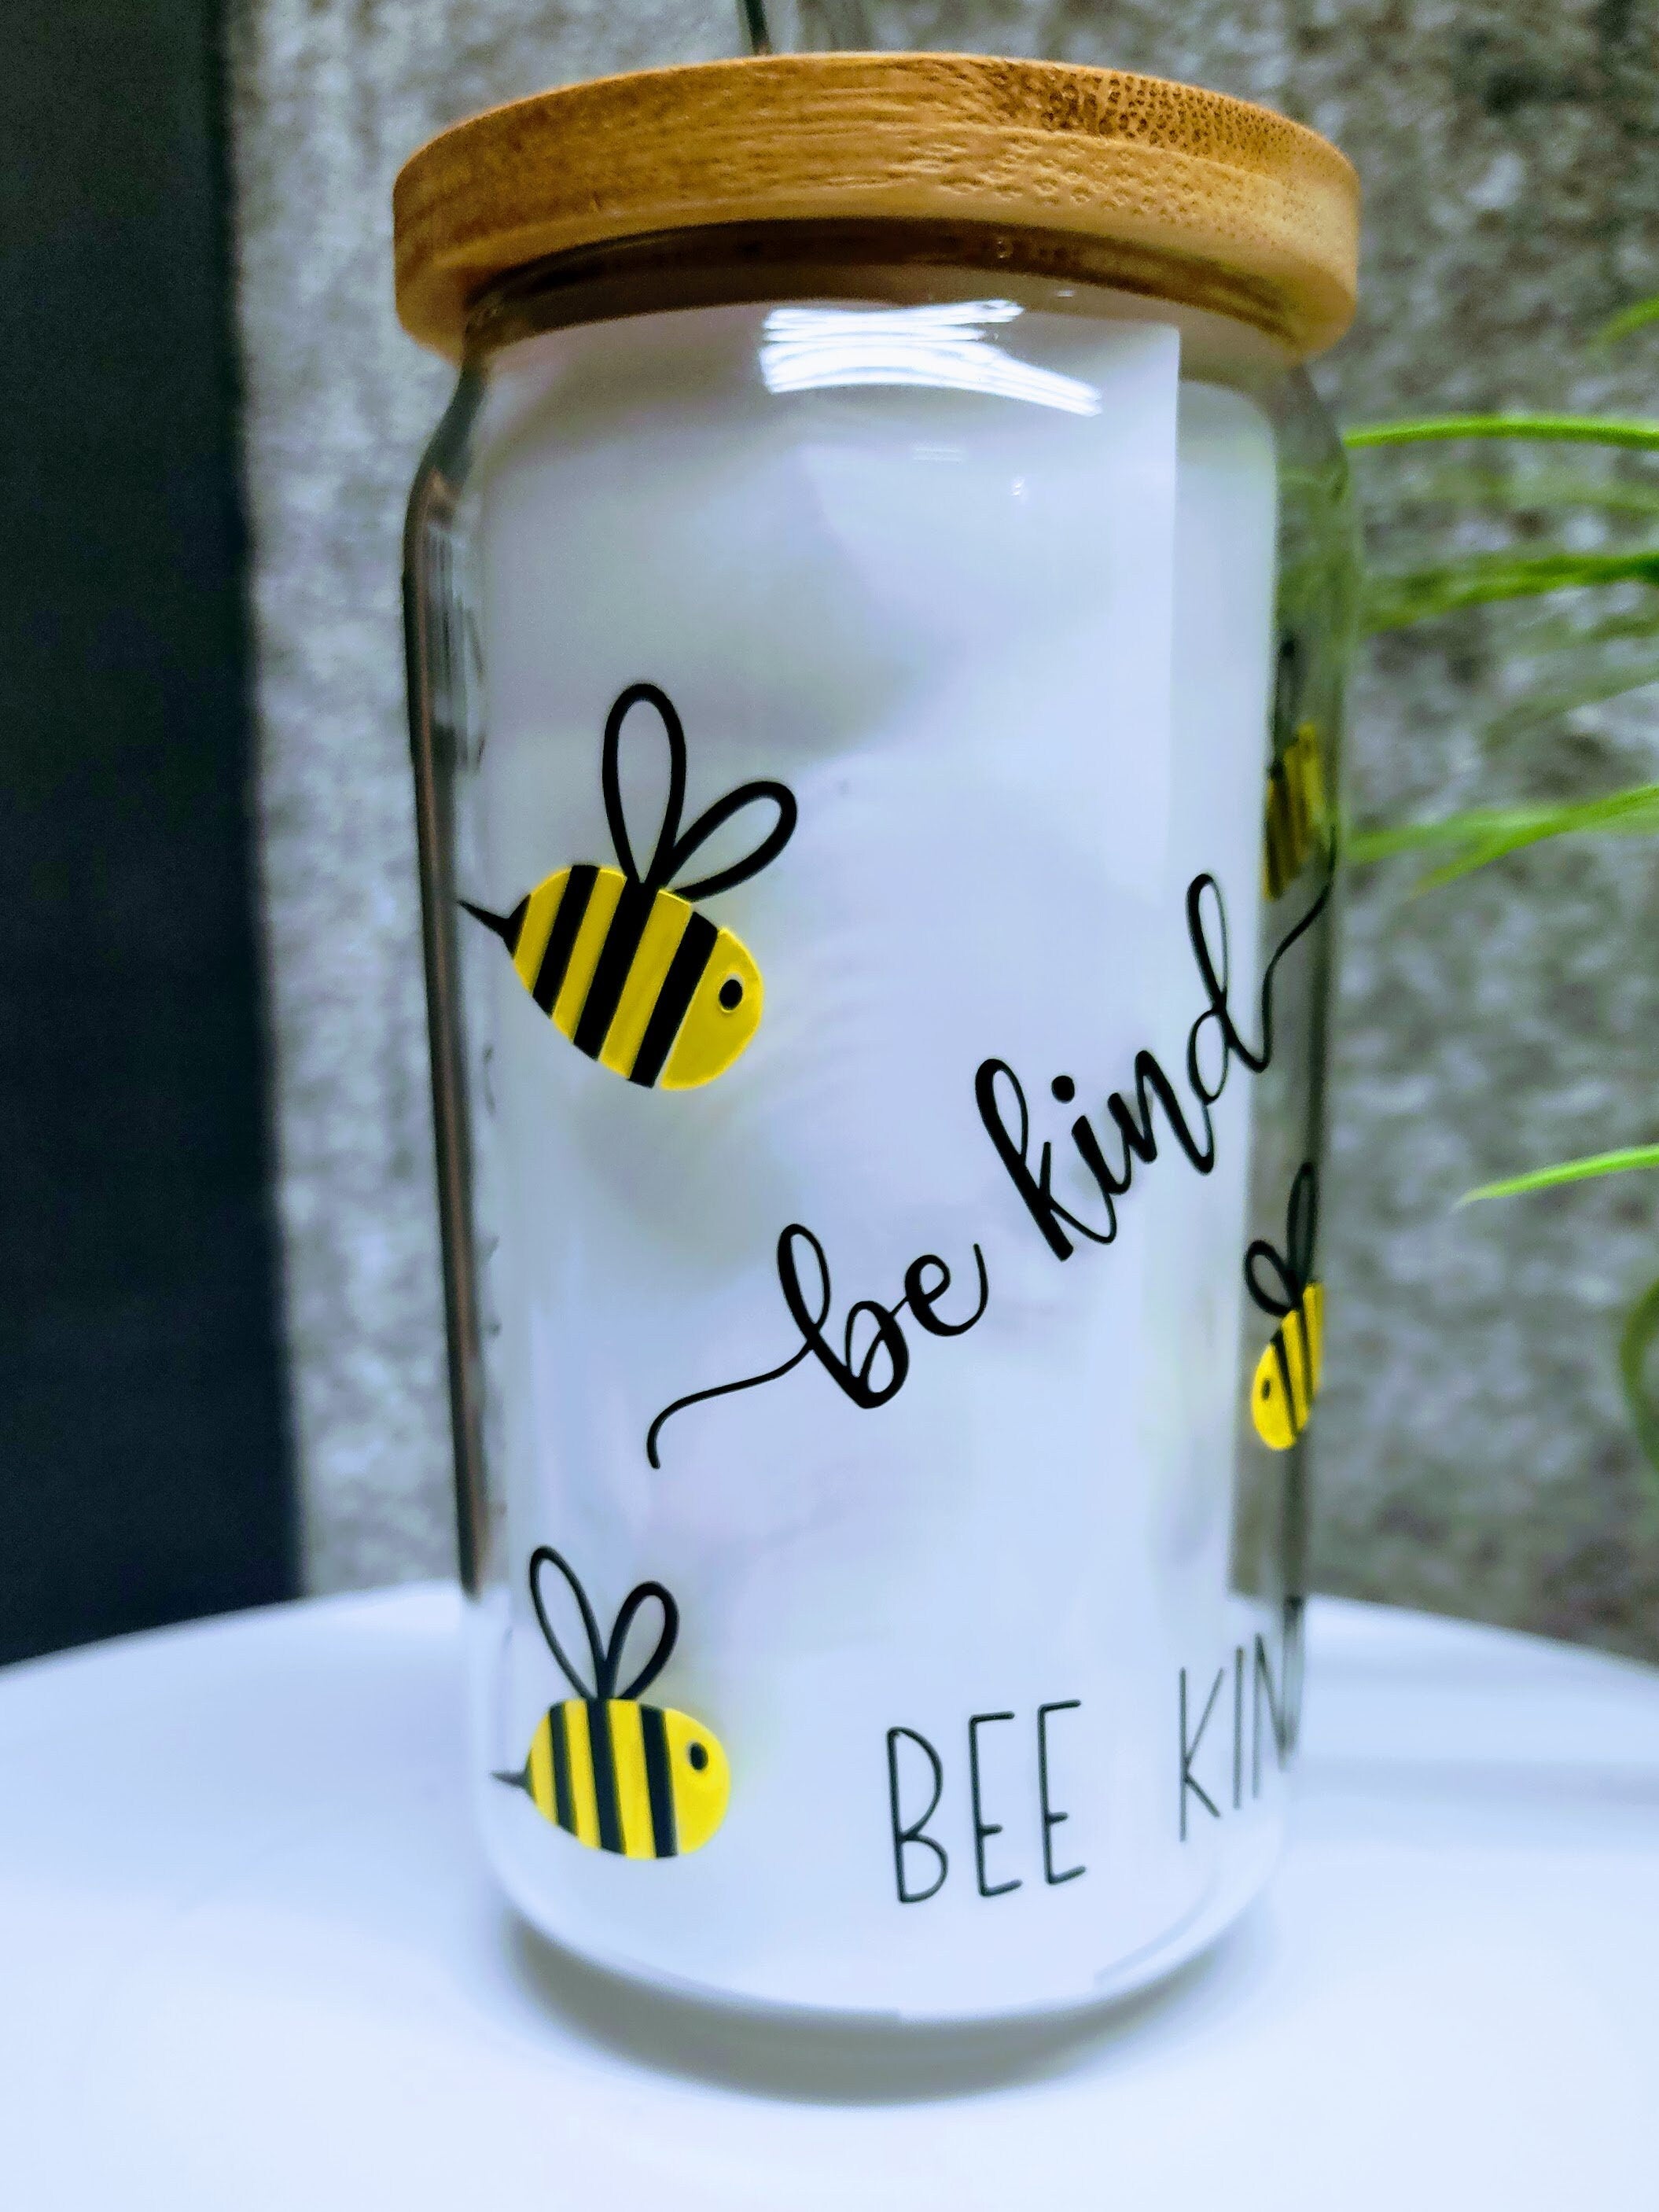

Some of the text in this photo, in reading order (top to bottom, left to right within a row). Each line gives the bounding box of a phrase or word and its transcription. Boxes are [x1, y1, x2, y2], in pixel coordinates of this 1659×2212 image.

[647, 824, 1334, 1470] be kind
[886, 1699, 1086, 1904] BEE
